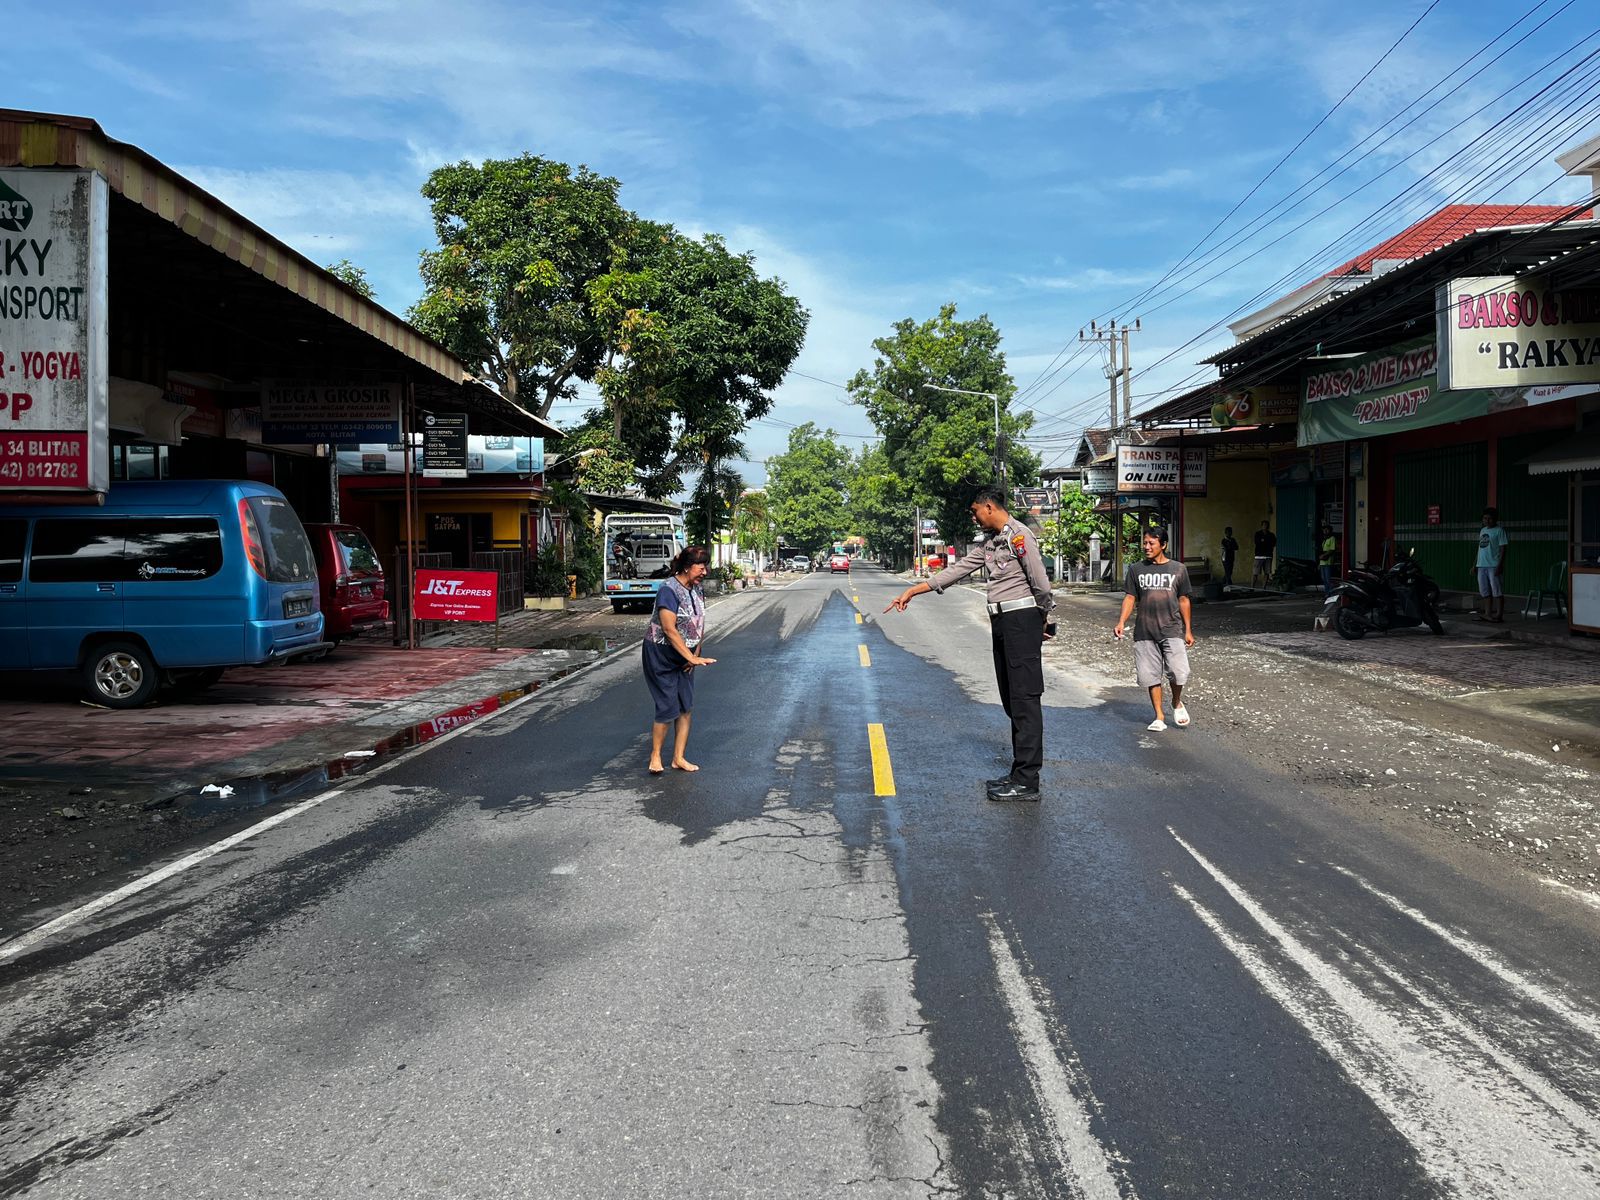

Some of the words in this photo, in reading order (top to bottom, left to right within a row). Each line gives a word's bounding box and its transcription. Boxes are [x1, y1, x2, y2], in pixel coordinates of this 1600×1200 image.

[0, 239, 52, 276] KY
[1458, 291, 1538, 329] BAKSO
[1541, 290, 1559, 325] &
[21, 351, 80, 380] YOGYA
[1307, 371, 1353, 401] BAKSO
[1368, 358, 1397, 388] MIE
[269, 389, 317, 404] MEGA
[323, 389, 391, 404] GROSIR
[1534, 388, 1546, 397] Kuat
[305, 431, 326, 439] KOTA
[330, 431, 356, 439] BLITAR
[8, 441, 24, 456] 34
[28, 441, 80, 456] BLITAR
[1122, 450, 1161, 461] TRANS
[1166, 451, 1204, 462] PAEM
[27, 462, 78, 478] 812782
[1151, 463, 1169, 471] TIKET
[1172, 463, 1203, 471] PEAWAT
[1125, 472, 1144, 482] ON
[1147, 472, 1178, 482] LINE
[440, 516, 455, 524] POS
[420, 579, 464, 596] J&T
[456, 588, 492, 597] EXPRESS
[1138, 573, 1176, 588] GOOFY
